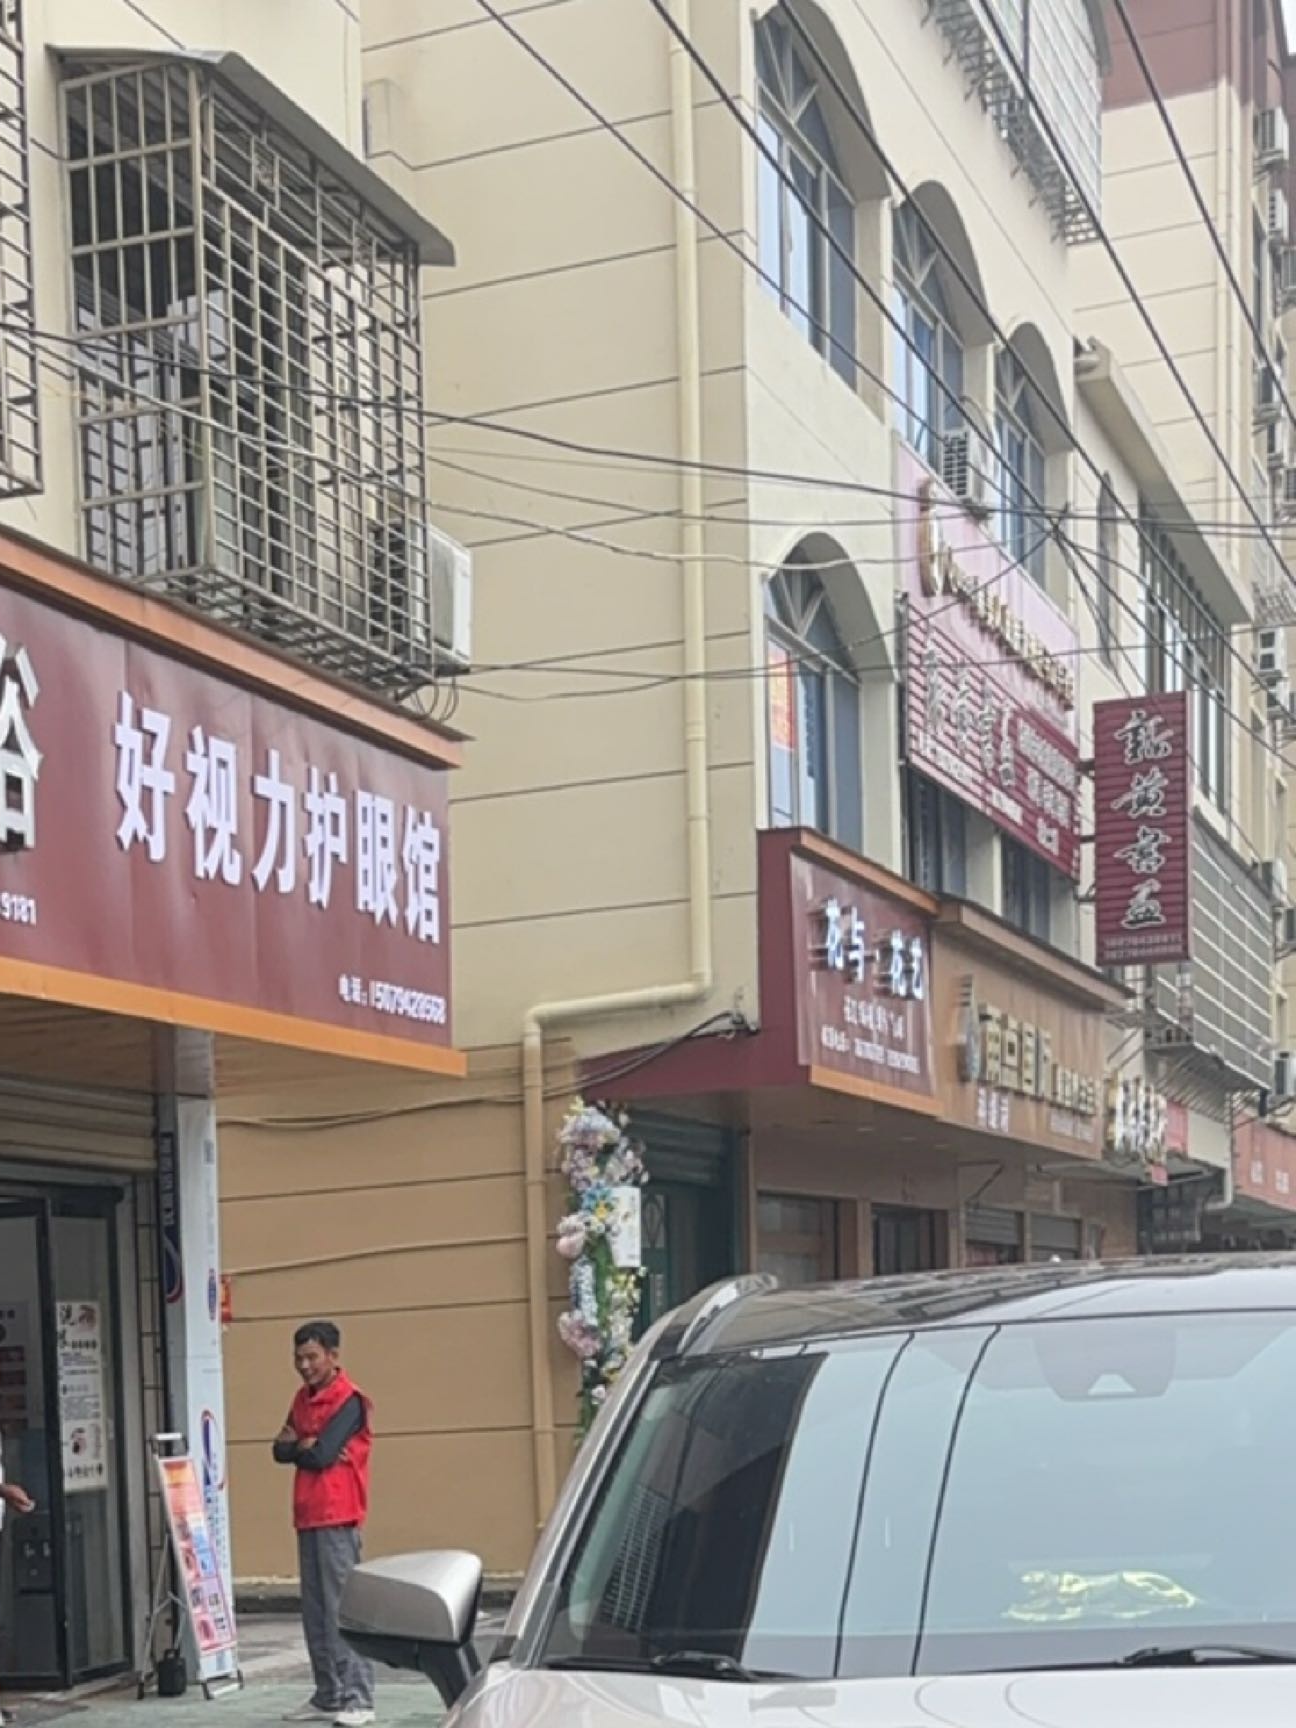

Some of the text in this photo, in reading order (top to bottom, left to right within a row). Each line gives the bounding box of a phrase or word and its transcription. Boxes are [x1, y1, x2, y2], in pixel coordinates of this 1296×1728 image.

[114, 691, 441, 944] 好视力护眼馆
